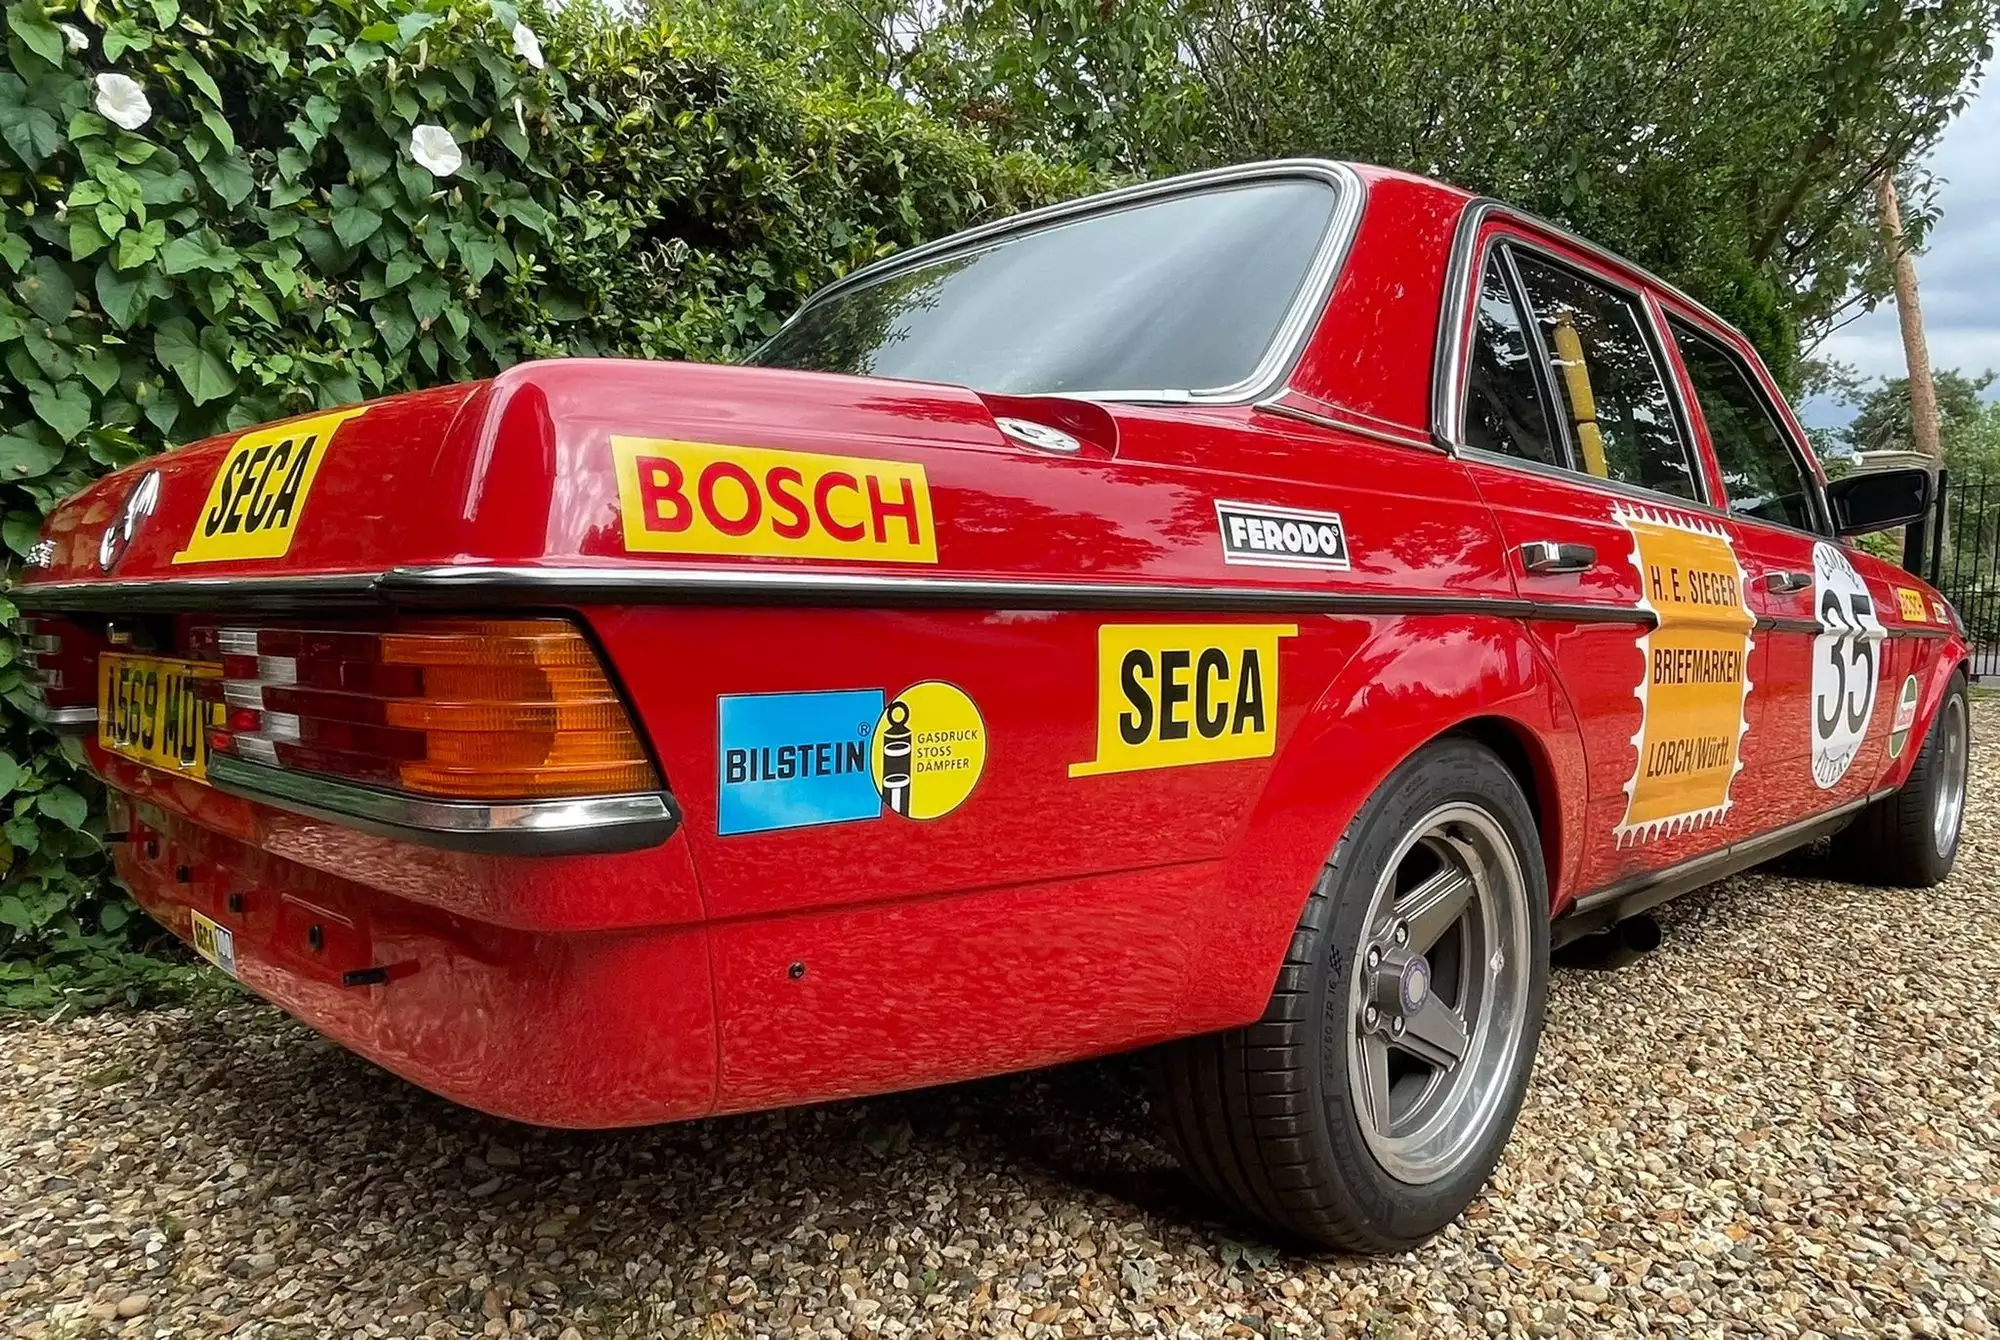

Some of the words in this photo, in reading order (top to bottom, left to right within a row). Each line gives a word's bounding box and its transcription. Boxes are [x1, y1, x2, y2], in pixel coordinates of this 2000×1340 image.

[205, 435, 317, 538] SECA
[635, 456, 920, 545] BOSCH
[1229, 516, 1338, 555] FERODO
[1650, 565, 1668, 601] H.
[1670, 568, 1686, 602] E.
[1688, 570, 1738, 607] SIEGER
[1653, 649, 1741, 685] BRIEFMARKEN
[1817, 589, 1873, 740] 35
[106, 665, 158, 750] A569
[1119, 648, 1265, 745] SECA
[917, 729, 978, 744] GASDRUCK
[917, 745, 952, 759] STOSS
[726, 740, 865, 784] BILSTEIN
